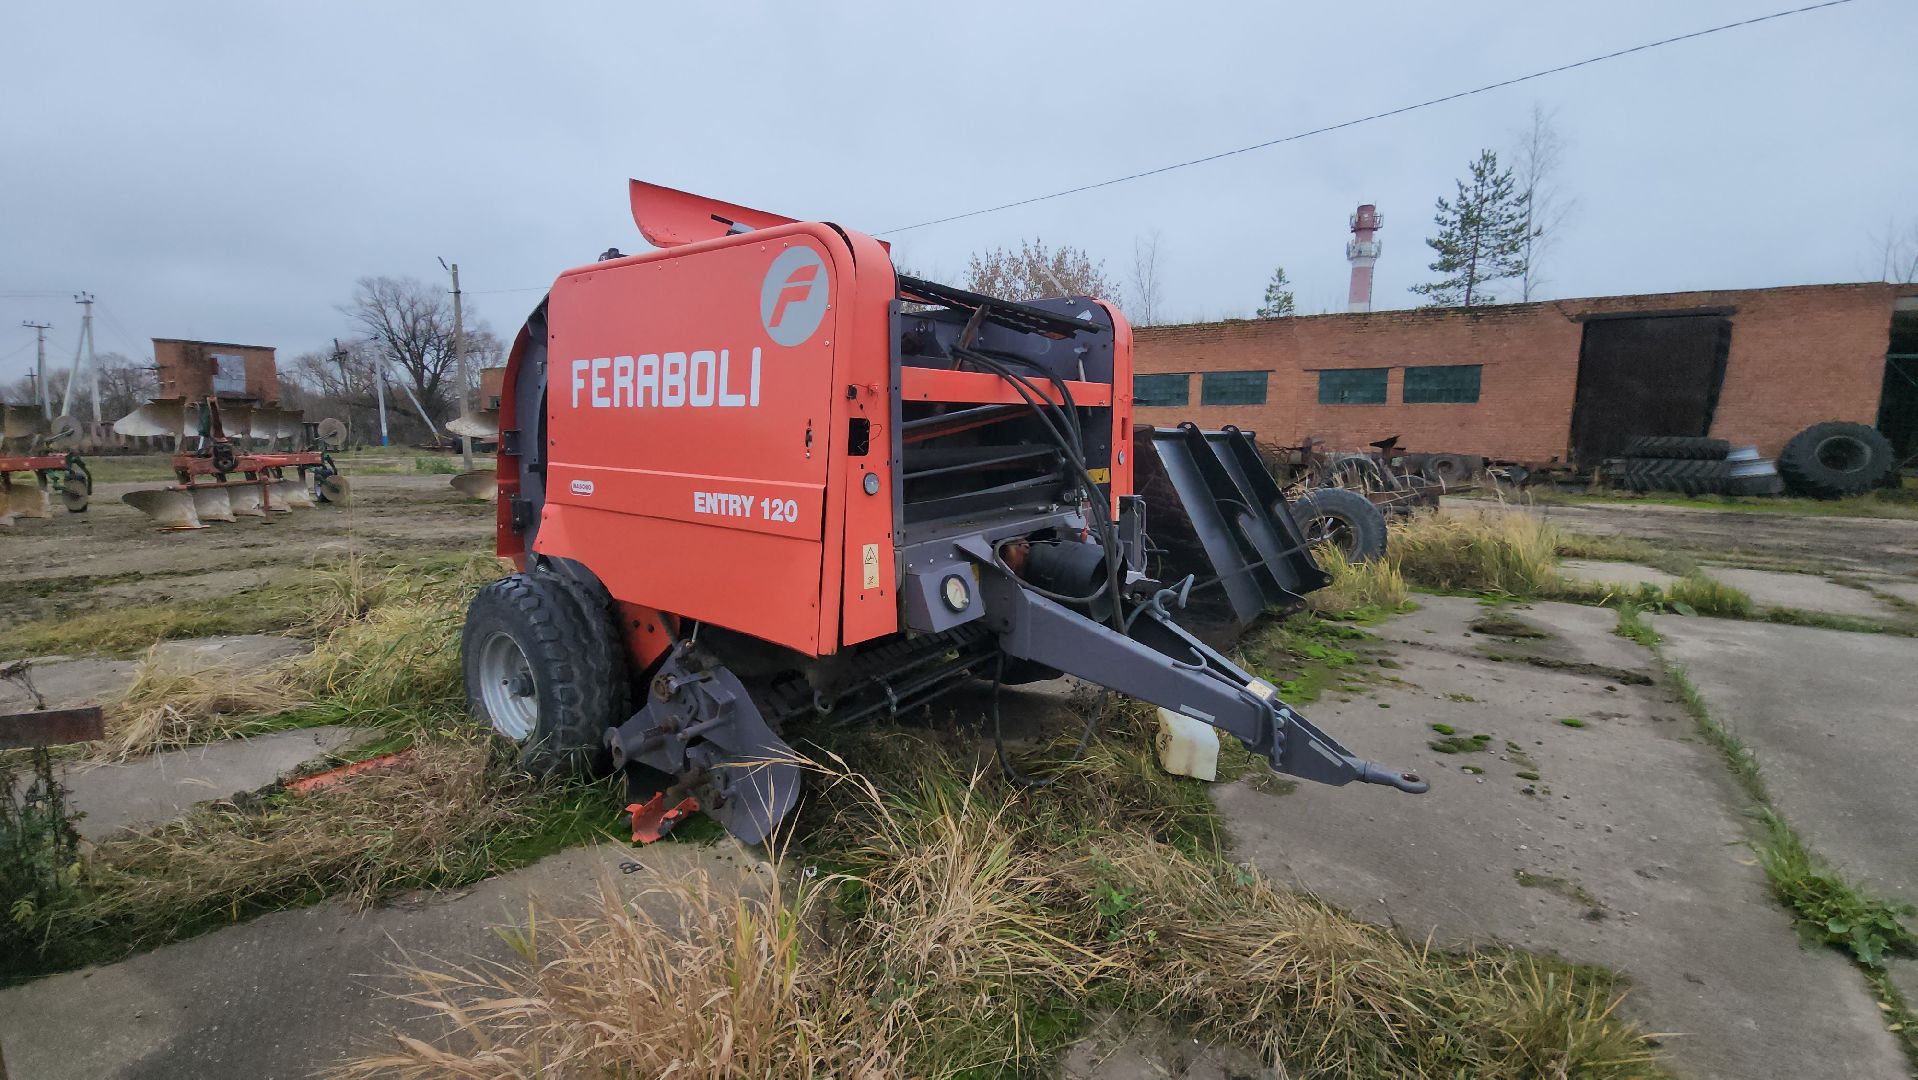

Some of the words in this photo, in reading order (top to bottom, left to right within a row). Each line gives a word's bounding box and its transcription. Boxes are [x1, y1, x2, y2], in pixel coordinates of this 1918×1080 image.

[572, 347, 762, 409] FERABOLI
[693, 491, 755, 518] ENTRY
[760, 497, 799, 523] 120
